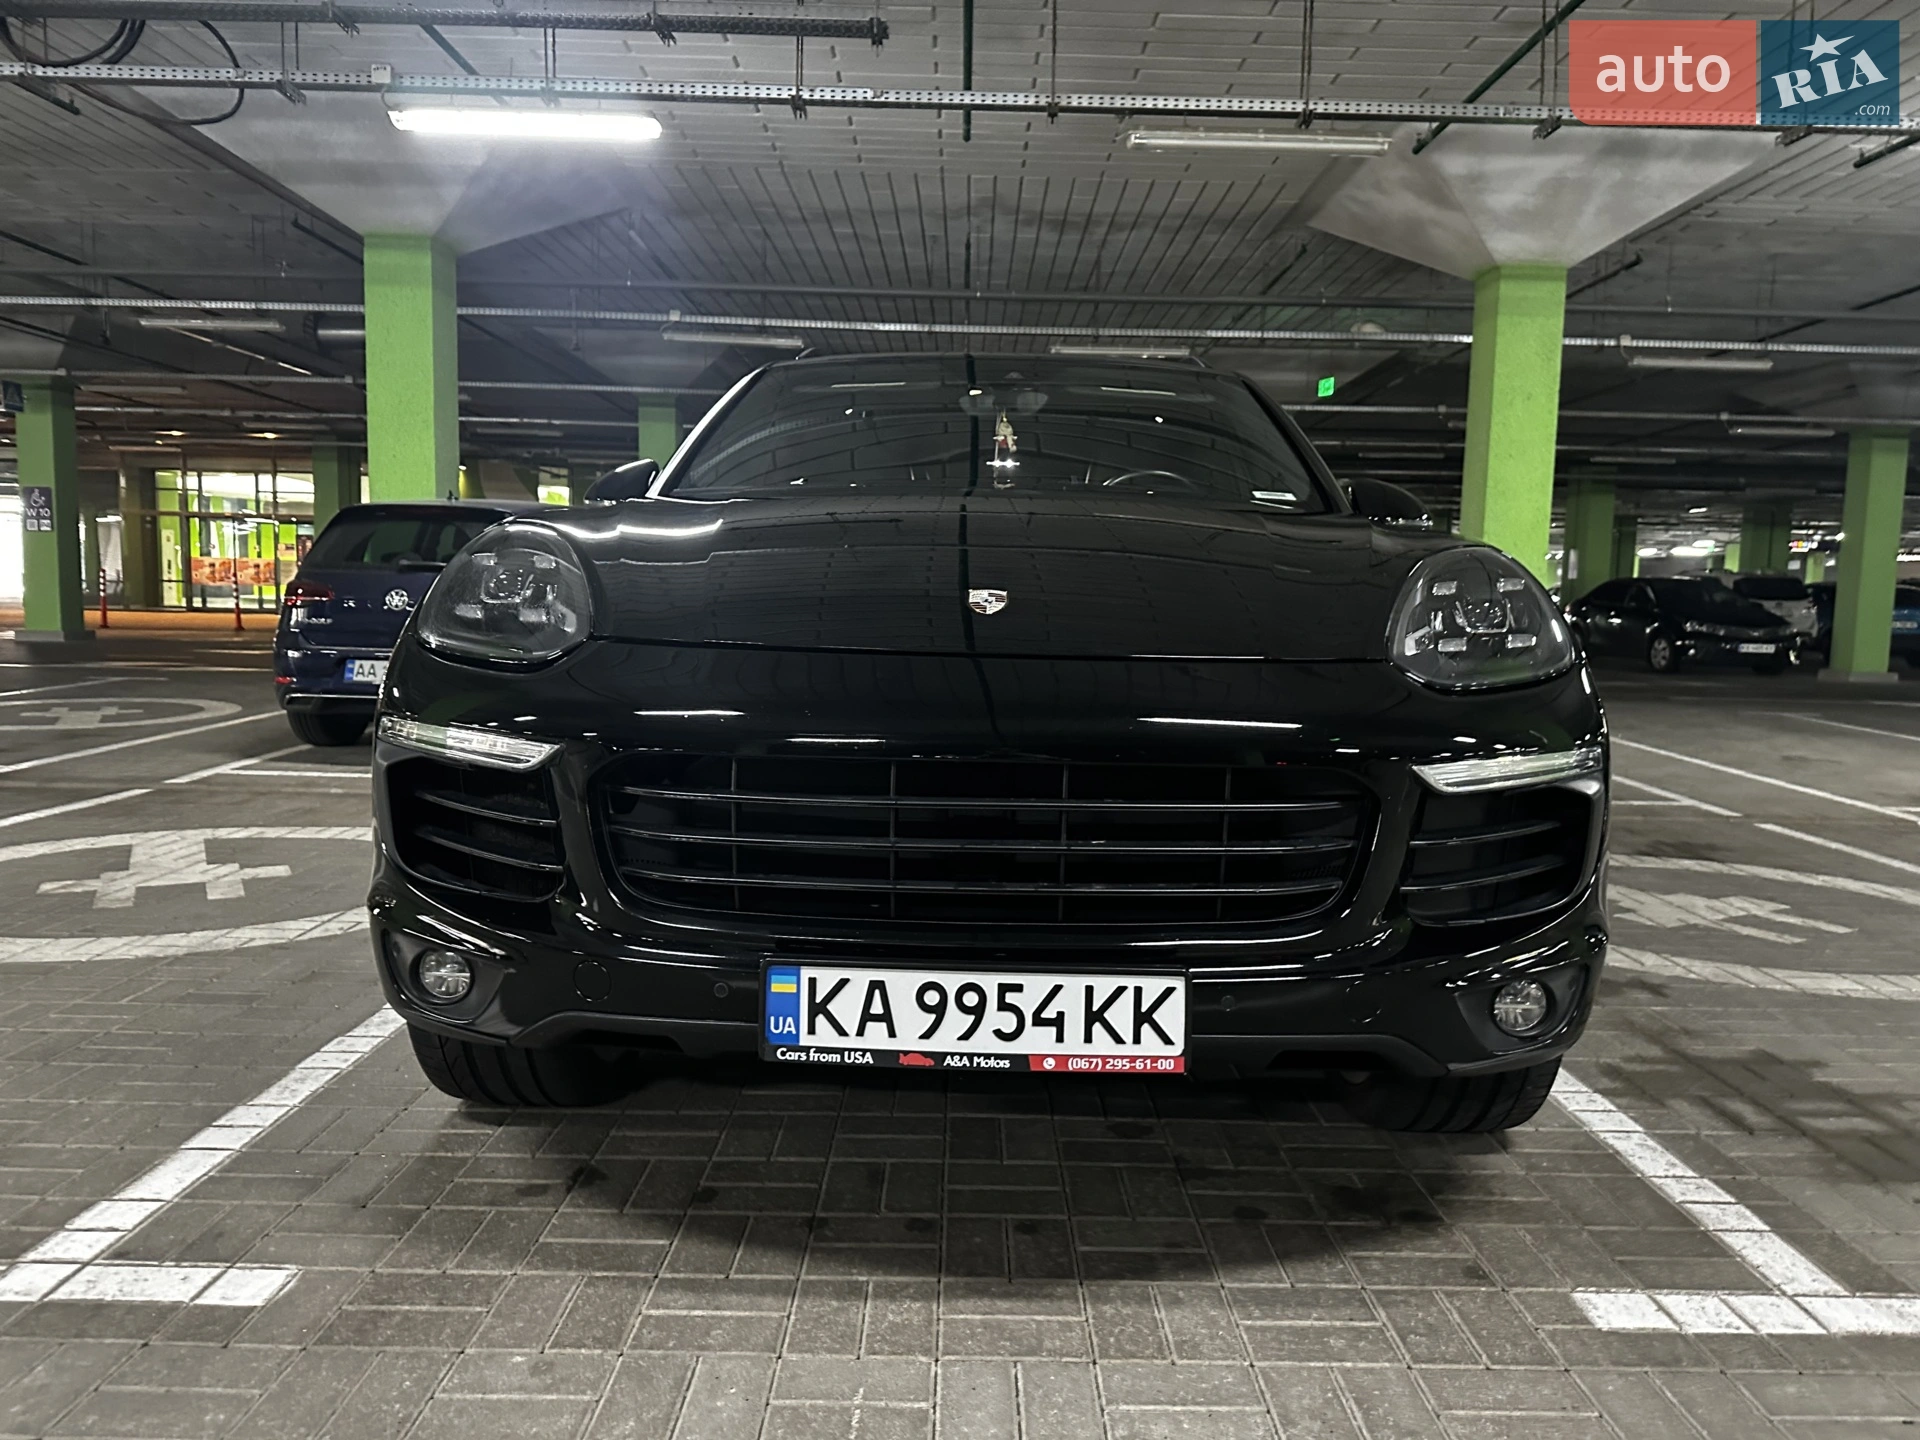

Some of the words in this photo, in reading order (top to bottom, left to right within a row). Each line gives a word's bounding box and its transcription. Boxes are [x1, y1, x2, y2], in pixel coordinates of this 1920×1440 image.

[355, 663, 377, 678] AA
[807, 976, 897, 1039] KA
[915, 980, 1065, 1044] 9954
[1083, 984, 1178, 1046] KK
[769, 1016, 797, 1035] UA
[776, 1047, 807, 1061] Cars
[809, 1048, 841, 1063] from
[844, 1050, 874, 1064] USA
[943, 1054, 970, 1067] A&A
[973, 1056, 1010, 1069] Motors
[1068, 1056, 1102, 1072] (067)
[1105, 1058, 1175, 1071] 295-61-00
